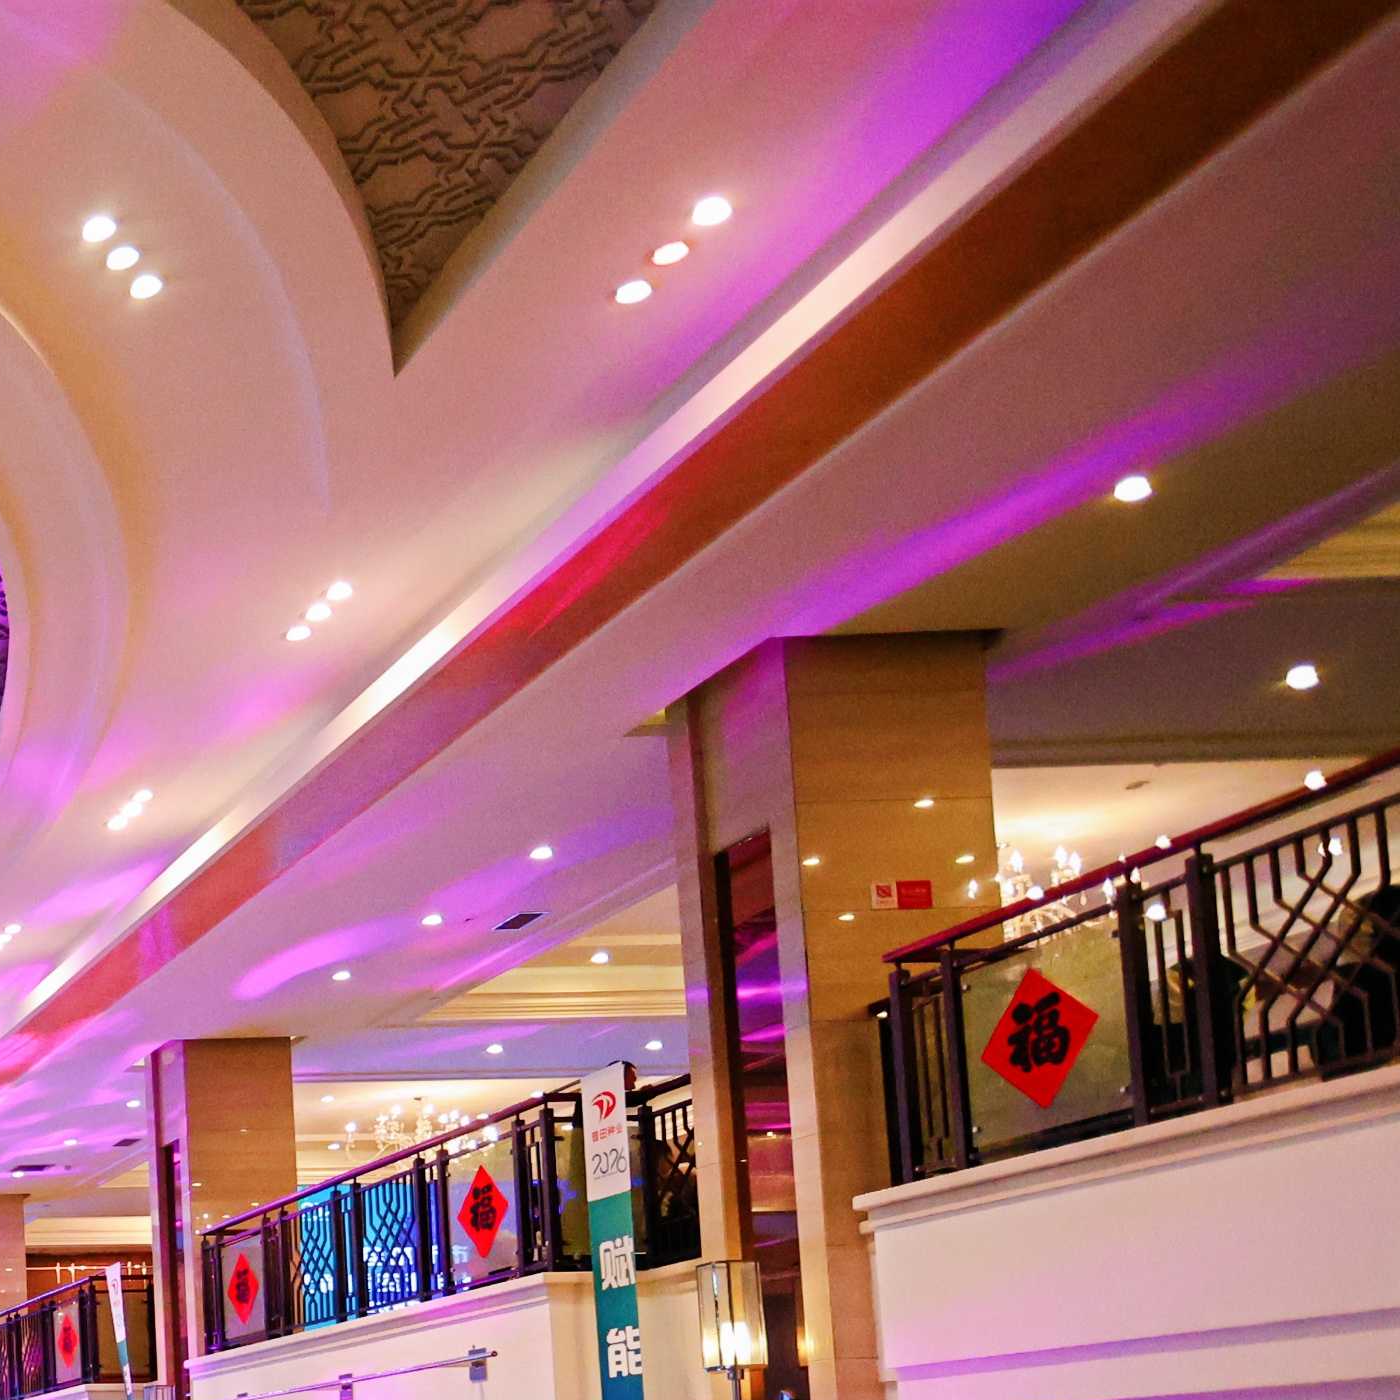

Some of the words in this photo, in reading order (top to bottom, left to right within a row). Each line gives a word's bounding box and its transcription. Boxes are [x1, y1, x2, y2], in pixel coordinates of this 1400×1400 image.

[1008, 992, 1071, 1073] 福
[592, 1147, 627, 1175] 2026
[469, 1185, 495, 1231] 福
